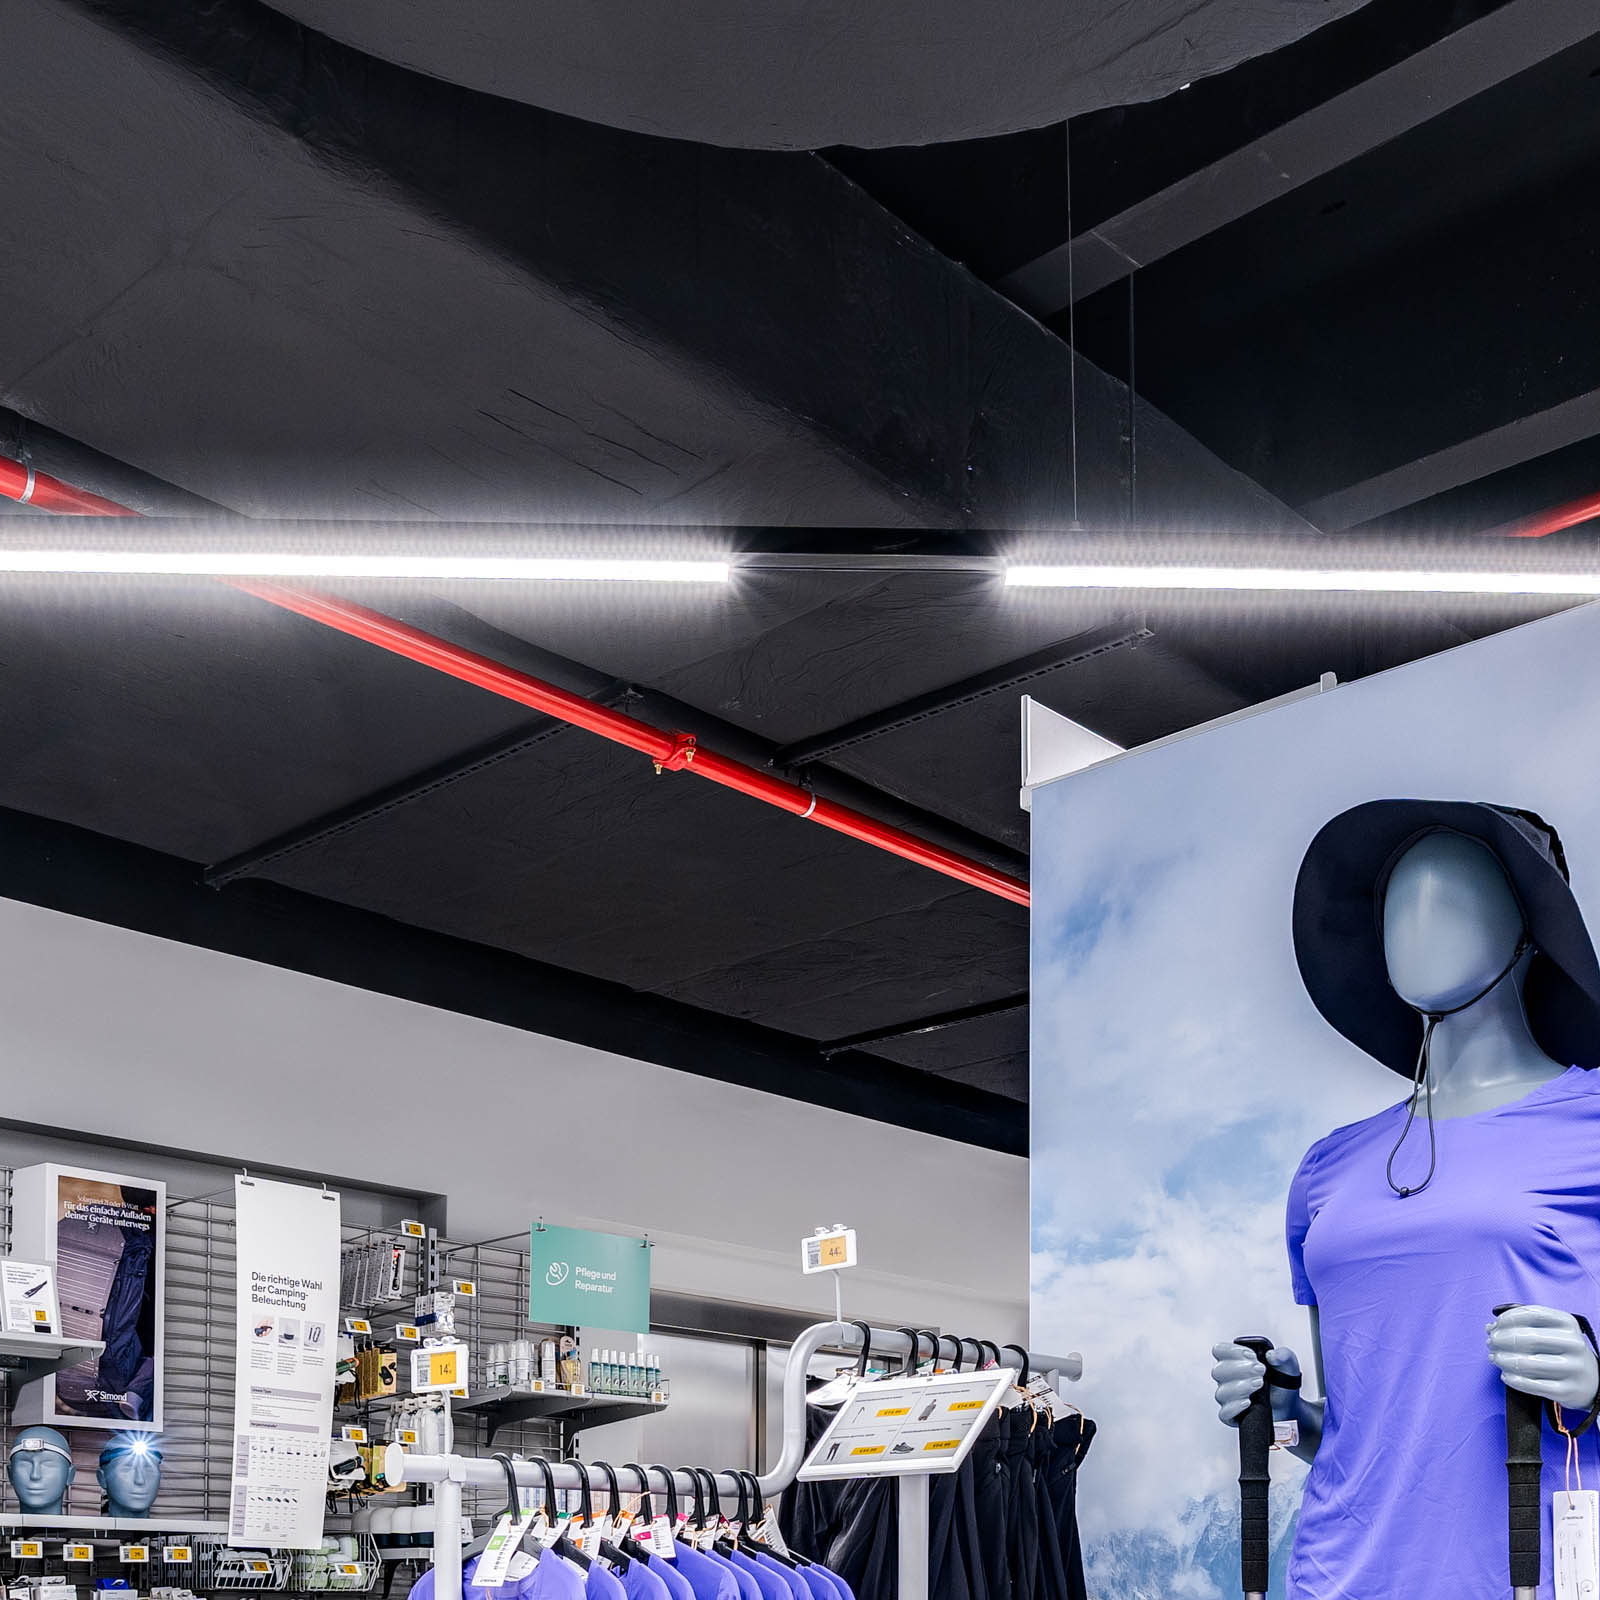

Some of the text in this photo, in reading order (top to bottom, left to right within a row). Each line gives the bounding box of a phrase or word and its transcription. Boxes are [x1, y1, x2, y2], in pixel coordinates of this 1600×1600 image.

[63, 1200, 152, 1222] Für das einfache Aufladen
[64, 1210, 150, 1231] deiner Geräte unterwegs
[251, 1271, 323, 1291] Die richtige Wahl
[575, 1266, 617, 1281] Pflege und
[251, 1283, 309, 1301] der Camping-
[575, 1280, 614, 1293] Reparatur
[251, 1293, 306, 1311] Beleuchtung
[100, 1390, 128, 1402] Simond
